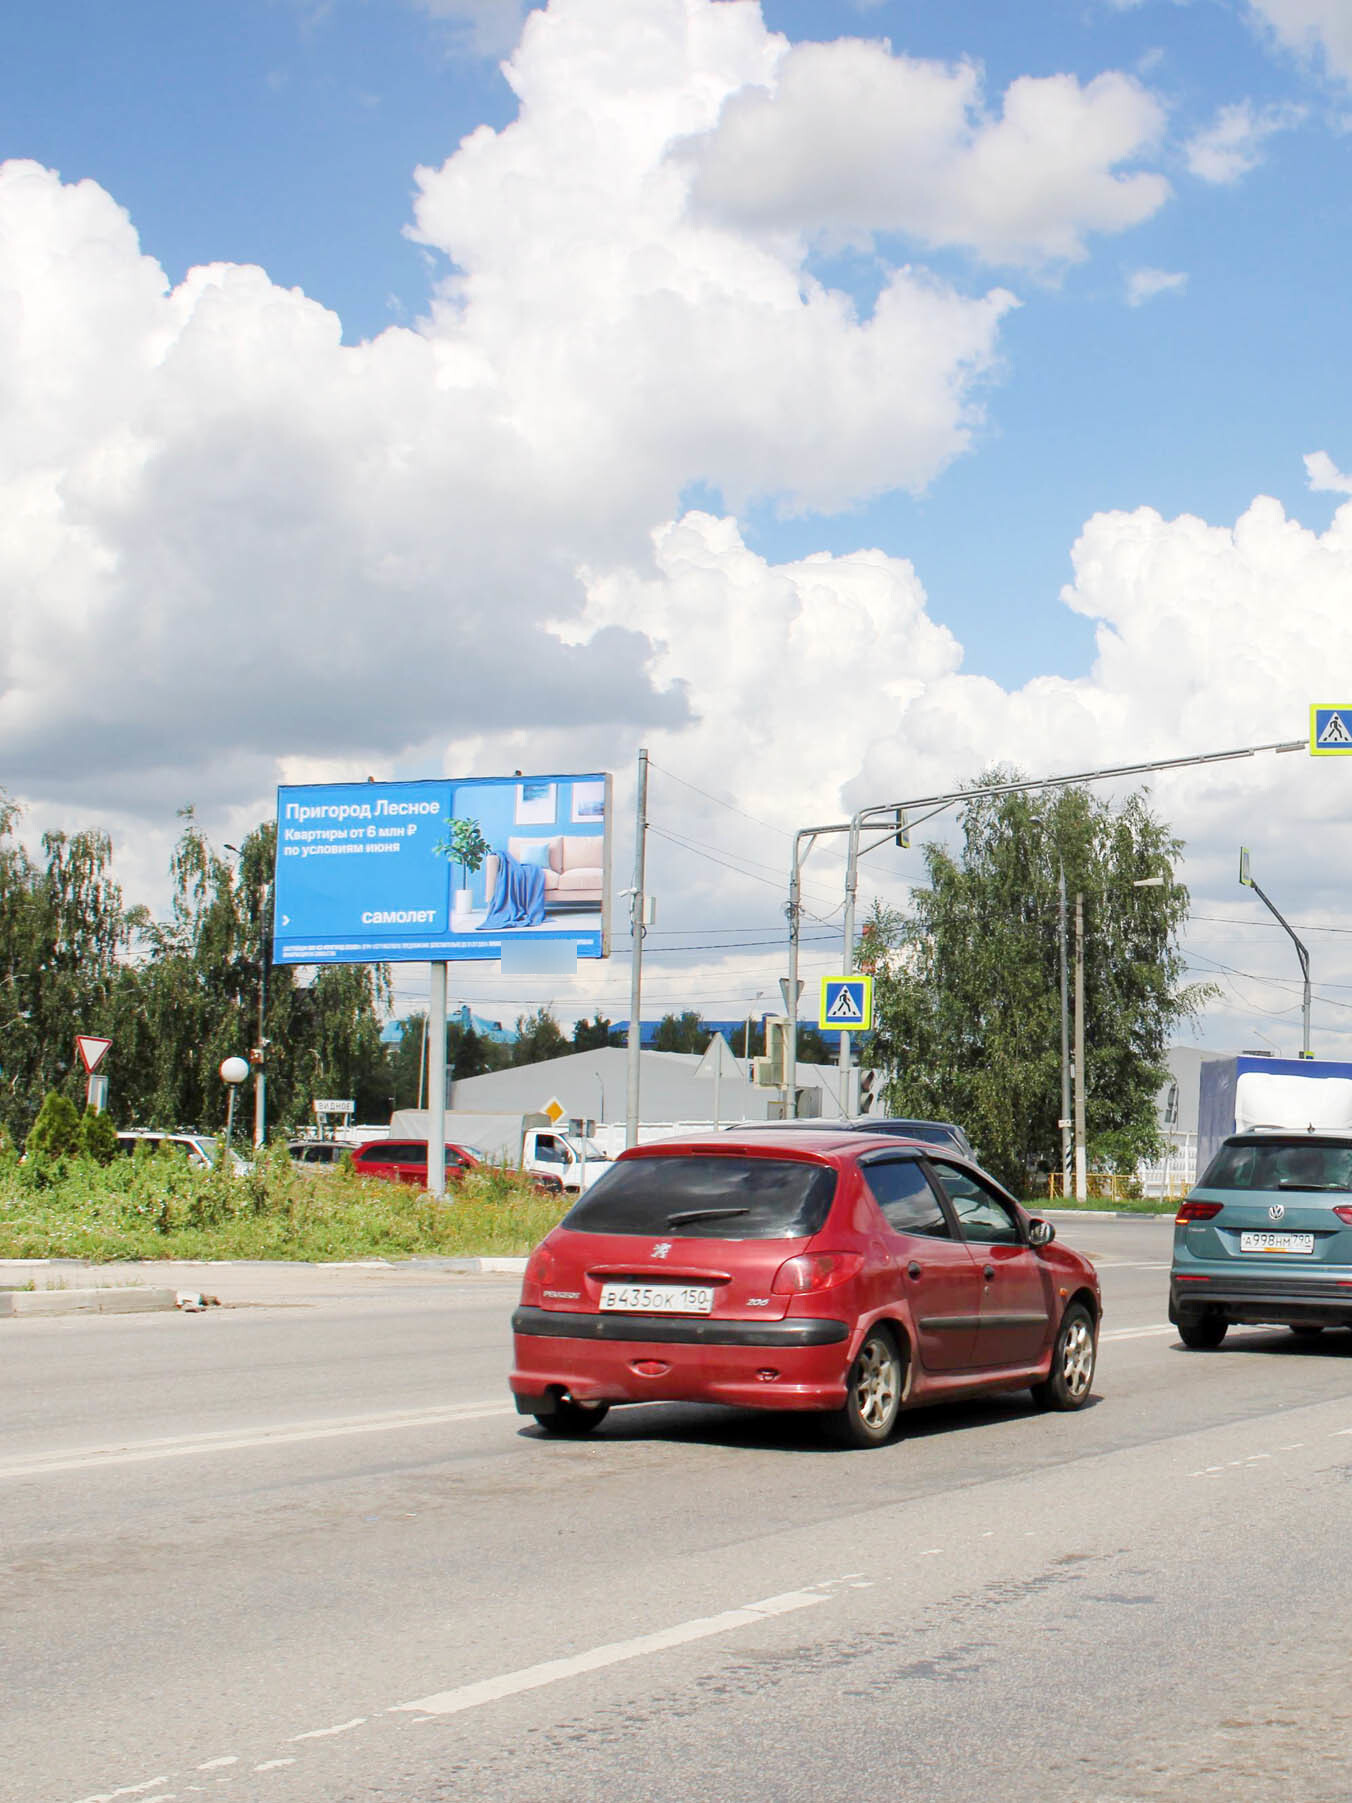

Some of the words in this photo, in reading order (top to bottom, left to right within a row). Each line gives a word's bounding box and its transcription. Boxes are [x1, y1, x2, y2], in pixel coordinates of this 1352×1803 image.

[286, 802, 372, 823] Пригород
[374, 799, 440, 816] Лесное
[284, 827, 348, 842] Квартиры
[349, 828, 363, 839] от
[366, 825, 377, 838] 6
[378, 827, 405, 838] млн
[284, 845, 300, 856] по
[301, 843, 363, 858] условиям
[366, 842, 401, 853] июня
[362, 909, 437, 924] самолет
